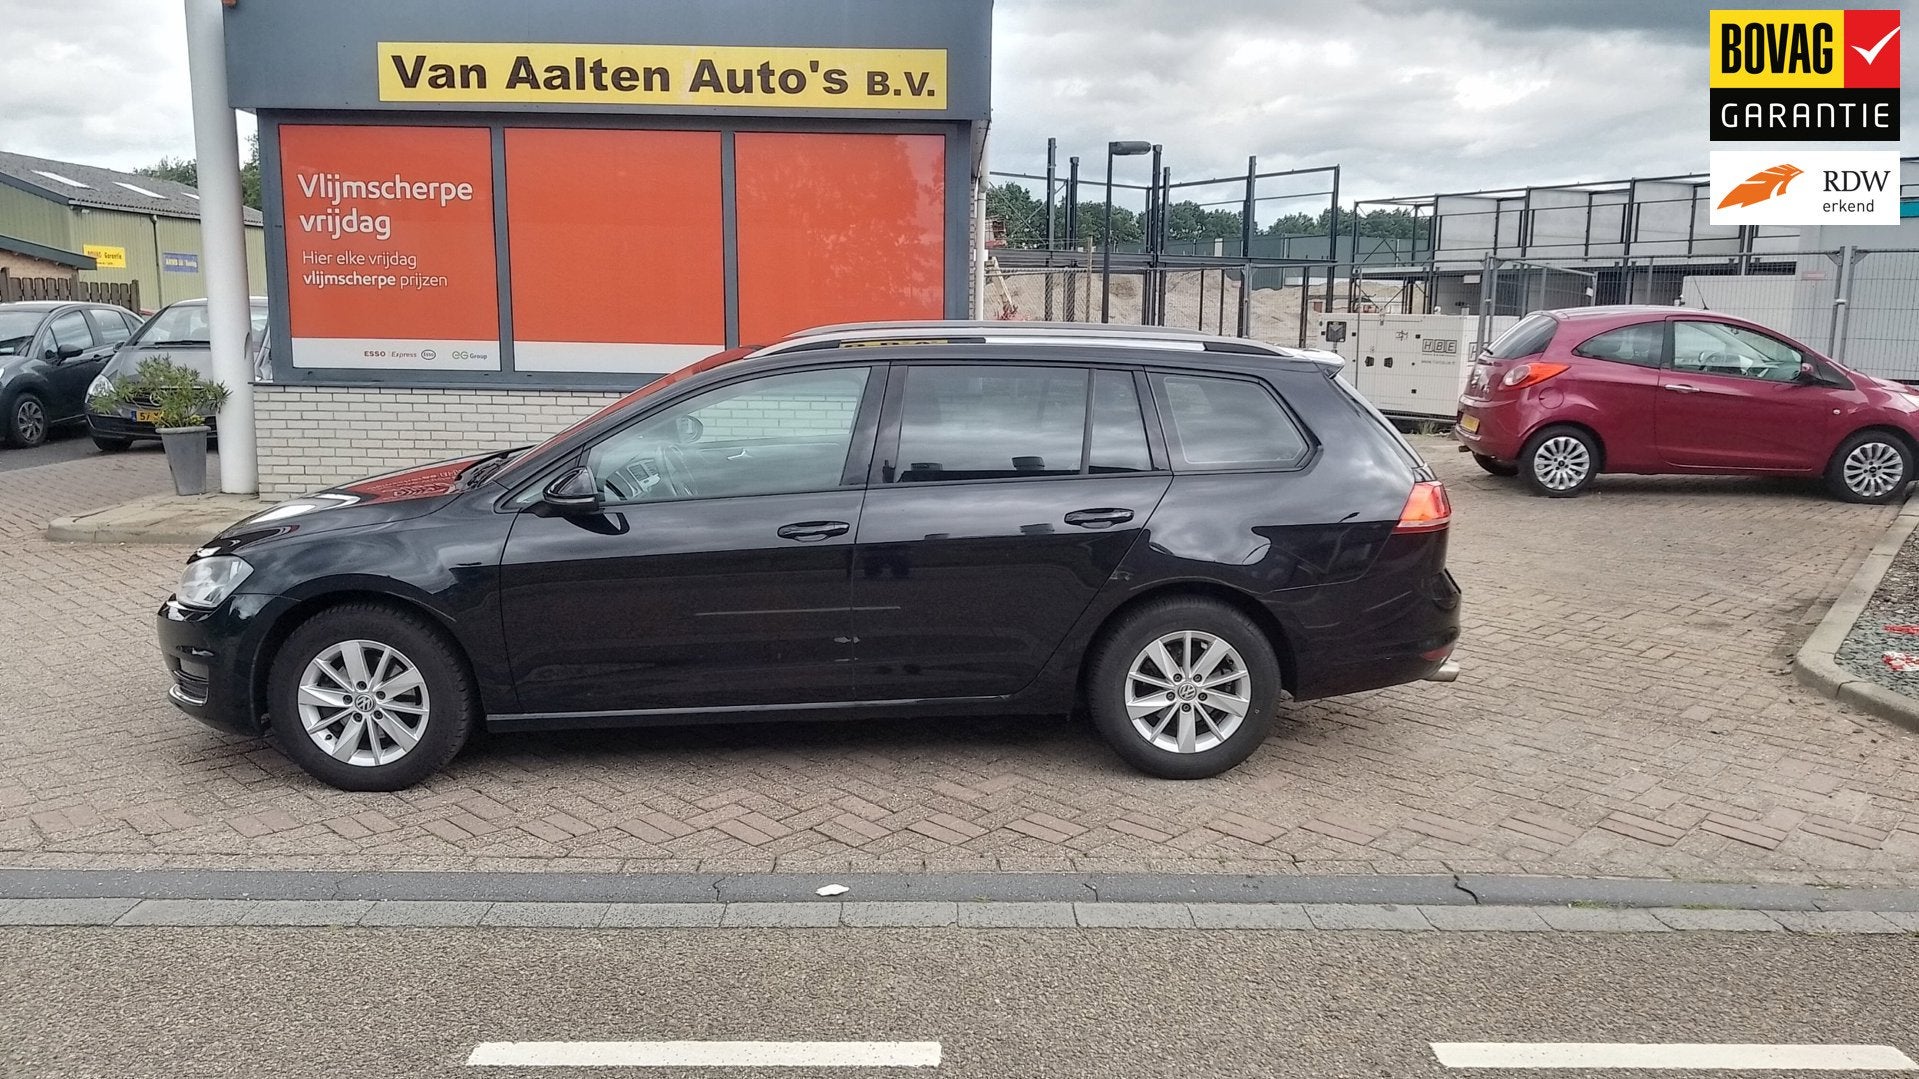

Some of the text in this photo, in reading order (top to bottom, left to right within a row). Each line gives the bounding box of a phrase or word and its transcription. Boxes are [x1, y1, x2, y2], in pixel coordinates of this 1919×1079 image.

[391, 54, 935, 97] Van Aalten Auto's B.V.
[297, 173, 473, 207] Vlijmscherpe
[299, 207, 391, 240] vrijdag
[302, 251, 417, 269] Hier elke vrijdag
[303, 271, 448, 290] vlijmscherpe prijzen
[391, 351, 417, 360] Express
[1423, 340, 1455, 352] HBE
